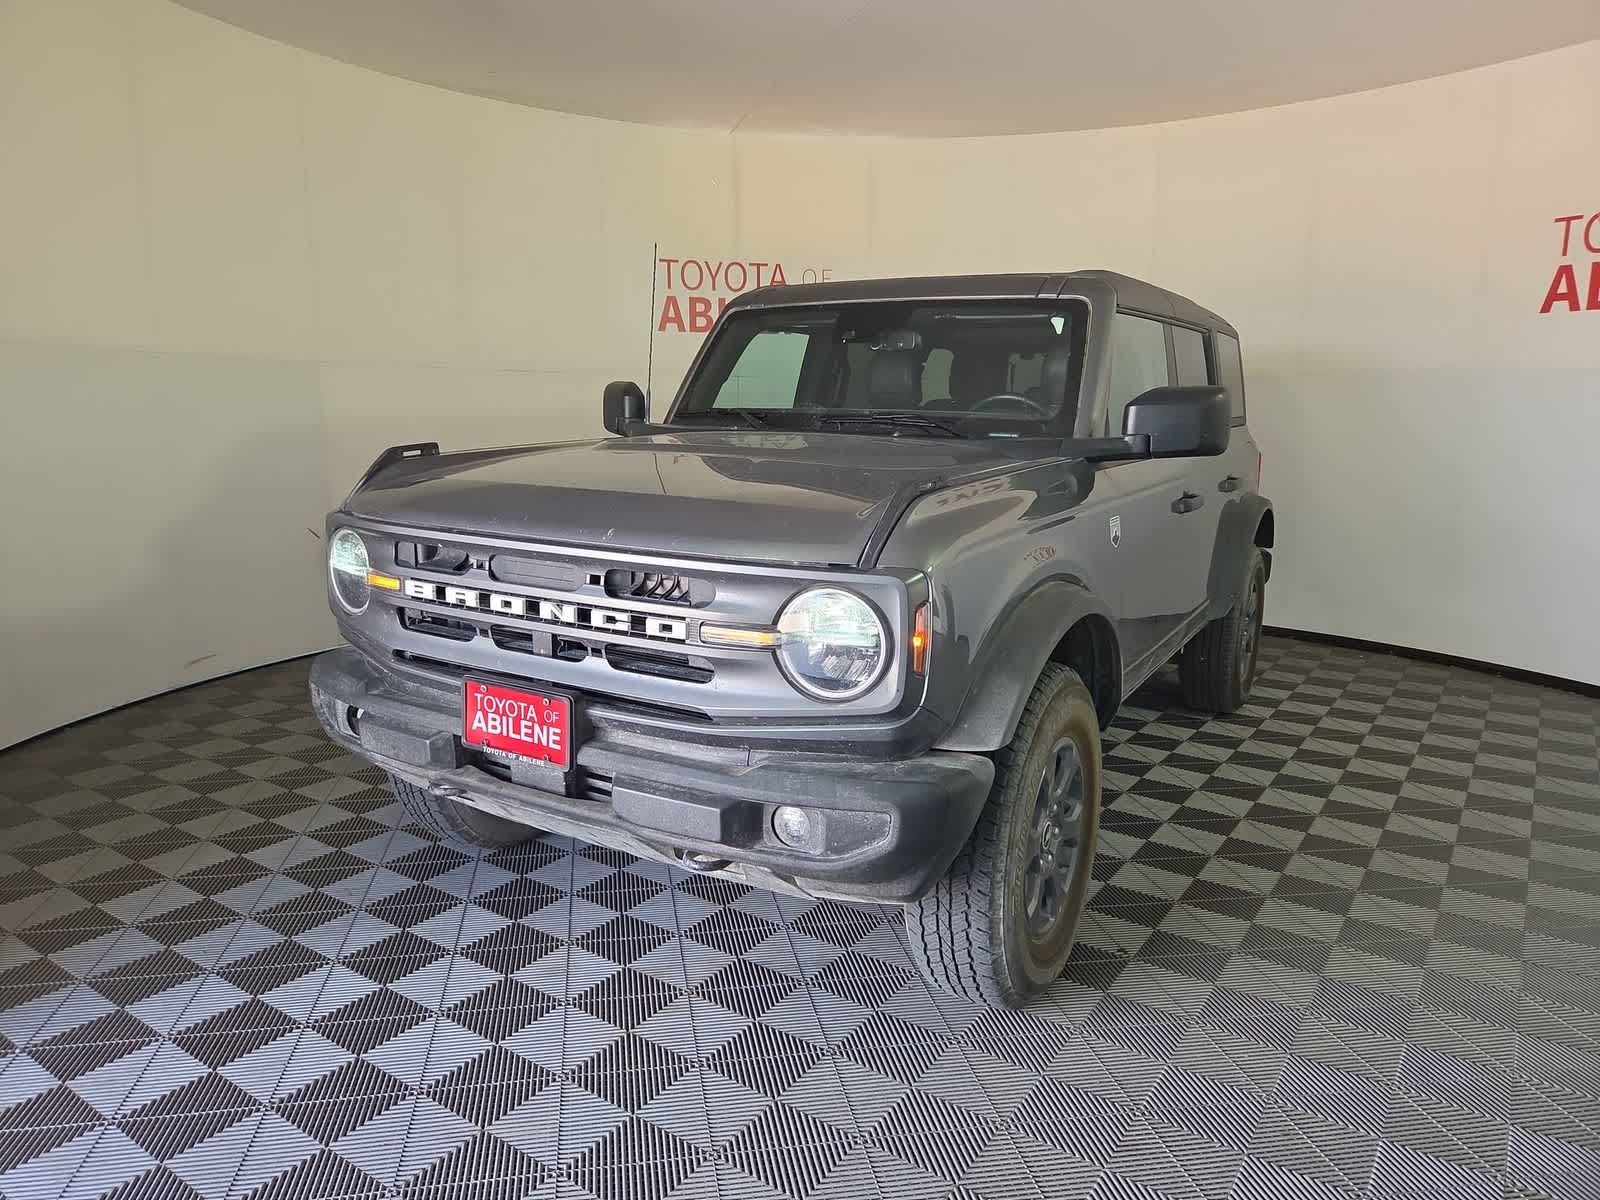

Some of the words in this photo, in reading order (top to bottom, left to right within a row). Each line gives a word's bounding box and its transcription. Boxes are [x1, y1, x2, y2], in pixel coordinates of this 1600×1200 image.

[658, 258, 788, 293] TOYOTA
[801, 268, 833, 285] OF
[403, 578, 690, 641] BRONCO
[474, 692, 538, 723] TOYOTA
[543, 709, 560, 723] OF
[471, 710, 562, 751] ABILENE
[482, 745, 506, 757] TOYOTA
[508, 752, 518, 760] OF
[519, 755, 545, 767] ABILENE
